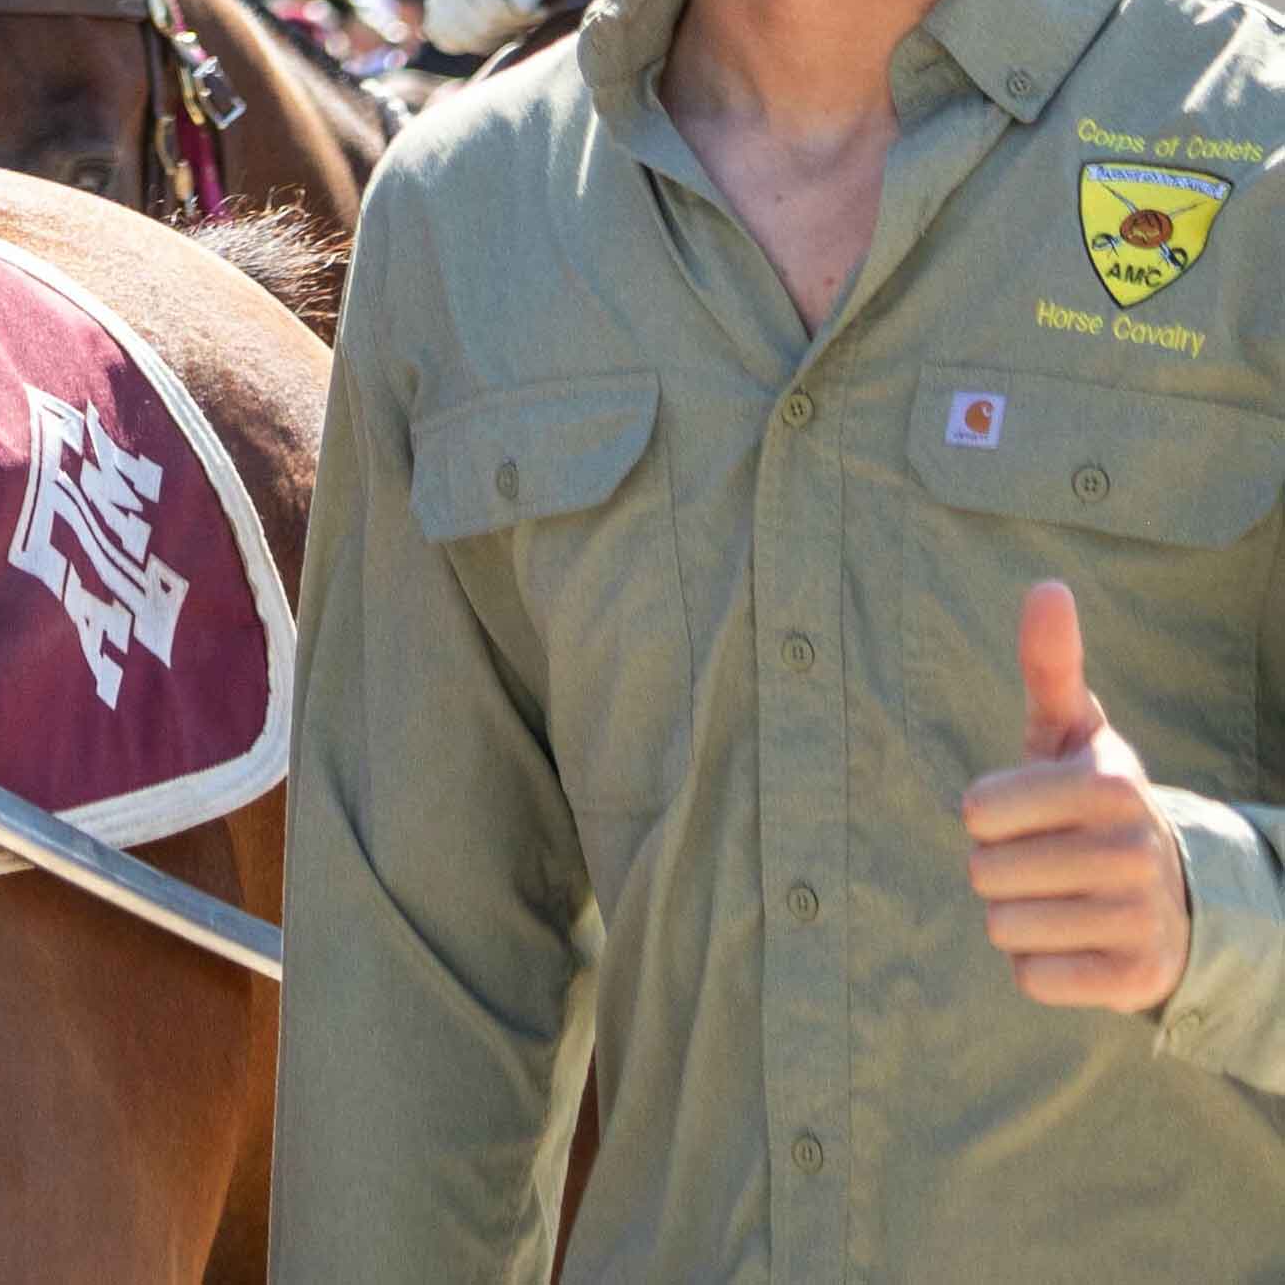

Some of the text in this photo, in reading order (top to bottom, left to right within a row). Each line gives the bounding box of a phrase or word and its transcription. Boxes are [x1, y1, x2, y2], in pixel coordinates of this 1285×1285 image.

[1078, 118, 1264, 162] Corps of Cadets
[1105, 262, 1163, 288] AMC
[1036, 298, 1207, 359] Horse Cavalry
